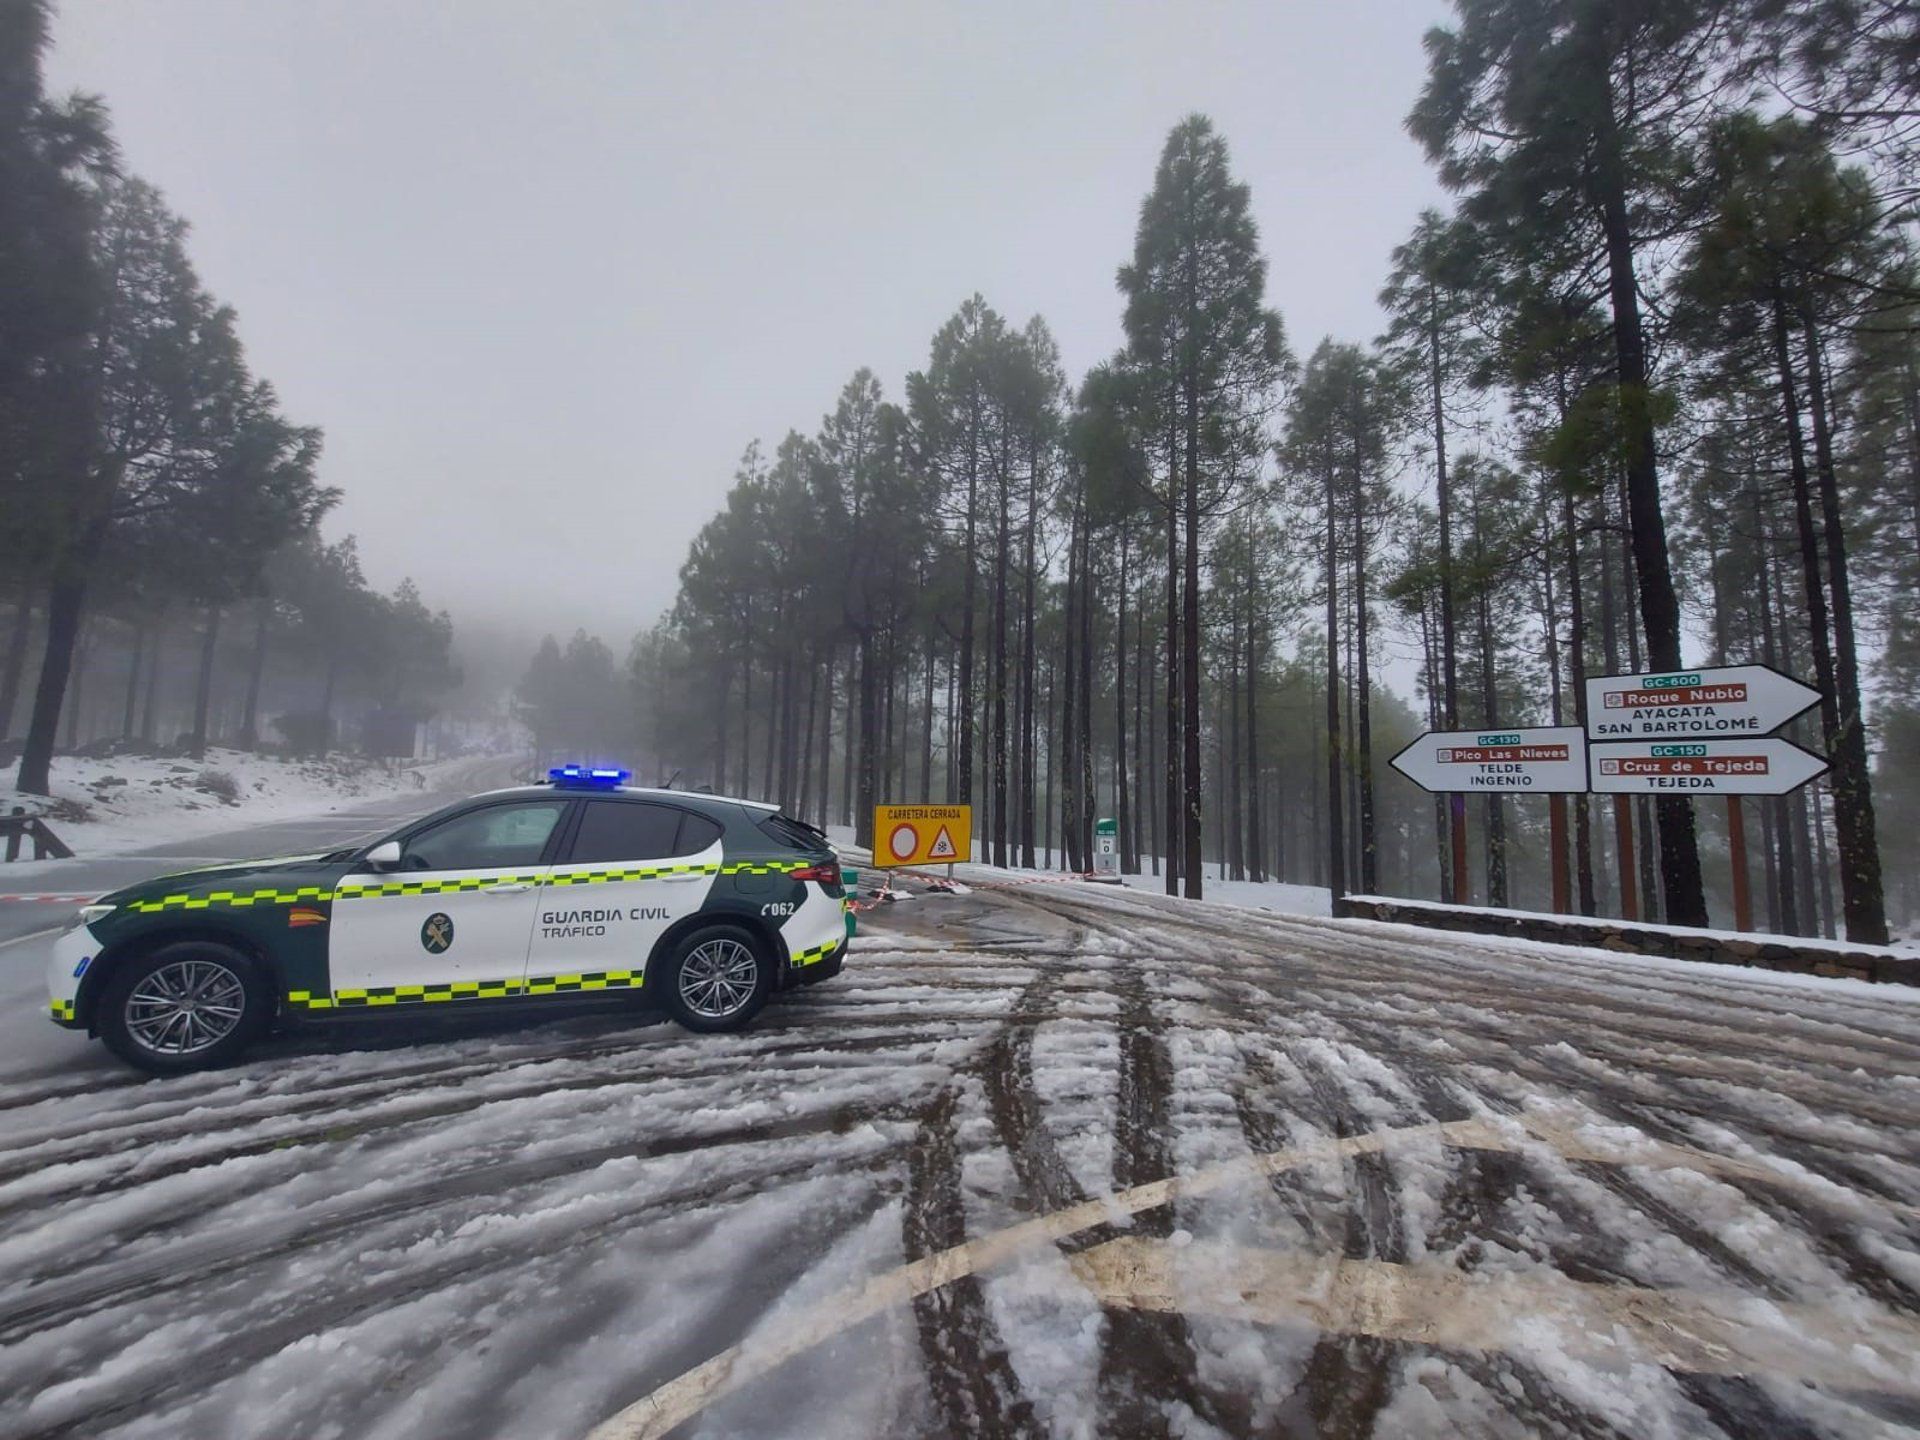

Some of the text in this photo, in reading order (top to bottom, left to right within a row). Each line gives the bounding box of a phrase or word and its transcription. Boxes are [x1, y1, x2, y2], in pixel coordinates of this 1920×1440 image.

[1644, 676, 1699, 688] GC-600
[1627, 687, 1745, 706] Roque Nublo
[1632, 706, 1716, 720] AYACATA
[1597, 716, 1760, 734] SAN BARTOLOMÉ
[1479, 736, 1519, 745] GC-130
[1455, 748, 1568, 760] Pico Las Nieves
[1652, 746, 1705, 756] GC-150
[1479, 763, 1524, 774] TELDE
[1623, 760, 1766, 774] Cruz de Tejeda
[1470, 776, 1532, 786] INGENIO
[1646, 777, 1715, 788] TEJEDA
[888, 808, 961, 820] CARRETERA CERRADA
[770, 902, 795, 916] 062
[542, 907, 671, 924] GUARDIA CIVIL
[541, 924, 606, 938] TRÁFICO
